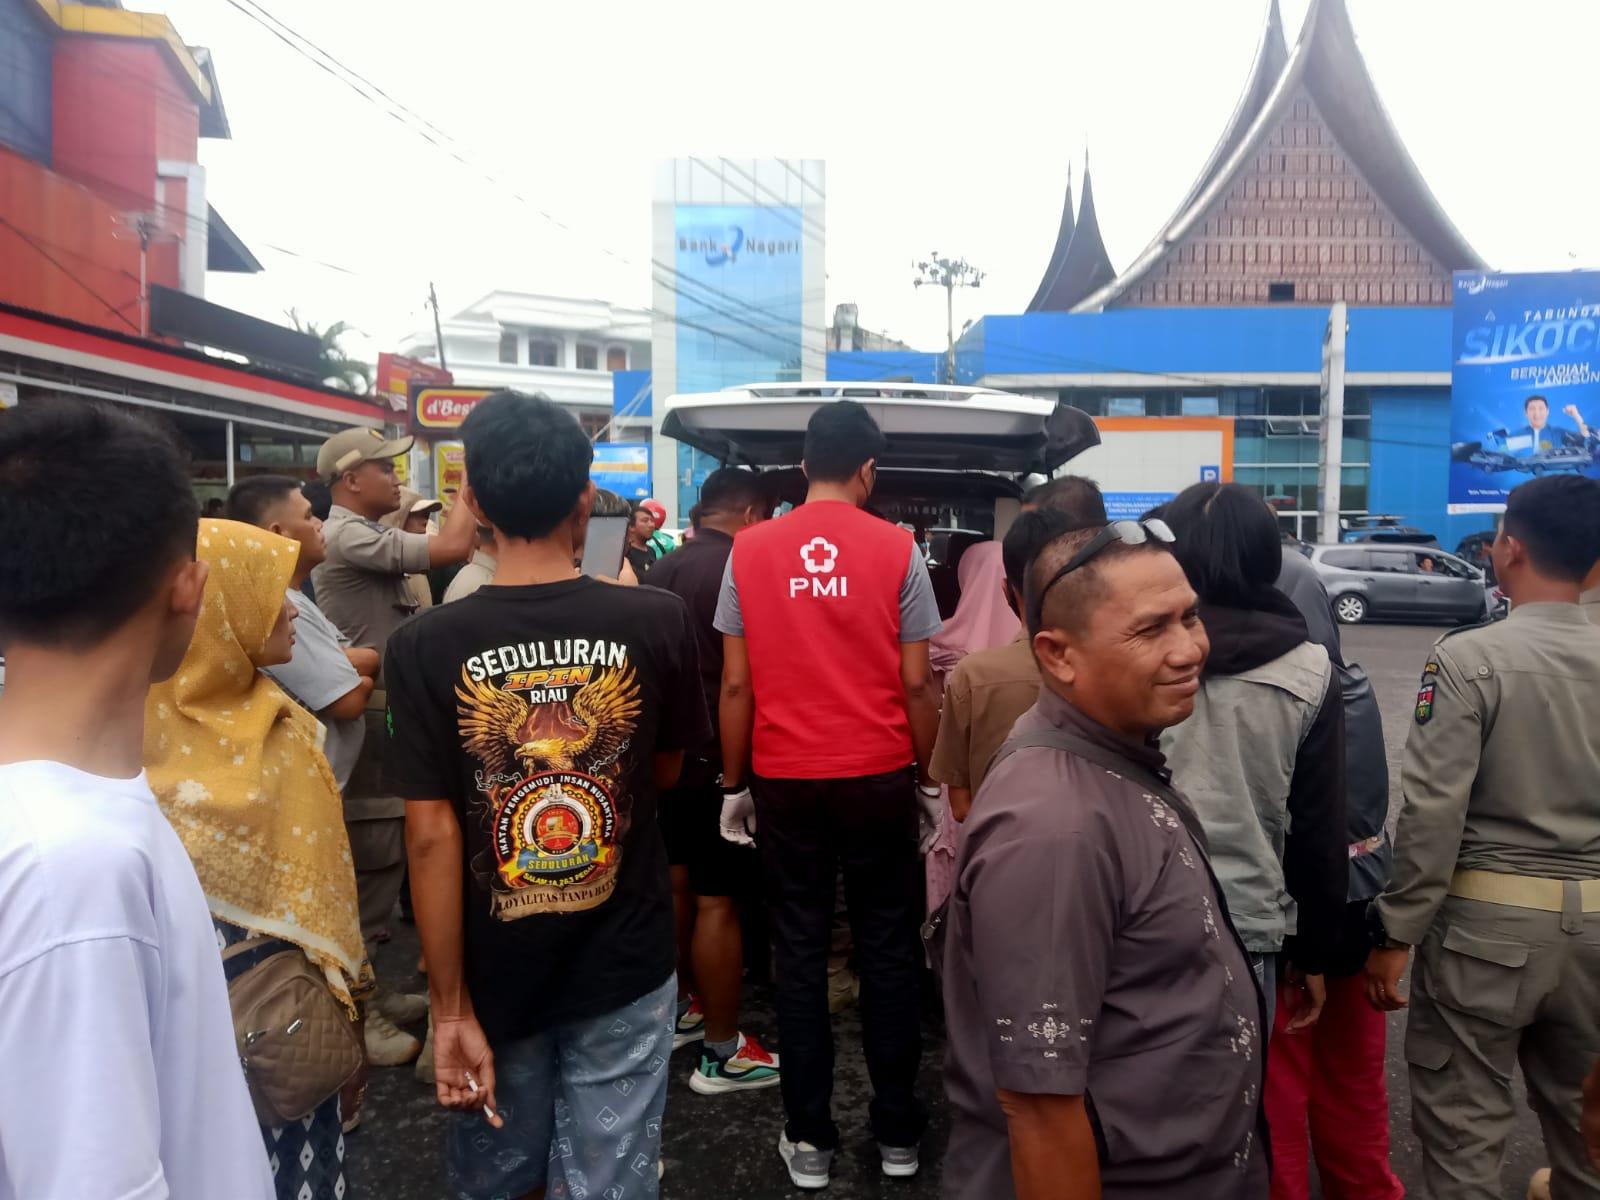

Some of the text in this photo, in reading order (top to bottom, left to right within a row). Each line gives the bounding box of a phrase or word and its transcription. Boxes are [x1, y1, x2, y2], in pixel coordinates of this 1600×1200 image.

[679, 237, 800, 256] Bank Nagari
[1510, 362, 1590, 380] BERHADIAH
[789, 576, 848, 598] PMI
[466, 638, 627, 682] SEDULURAN
[530, 688, 568, 704] RIAU
[498, 817, 510, 855] IKATAN
[504, 776, 554, 815] PENGEMUDI
[560, 775, 590, 789] INSAN
[589, 785, 613, 838] NUSANTARA
[528, 853, 590, 870] SEDULURAN
[500, 891, 557, 911] LOYALITAS
[557, 889, 593, 903] TANPA
